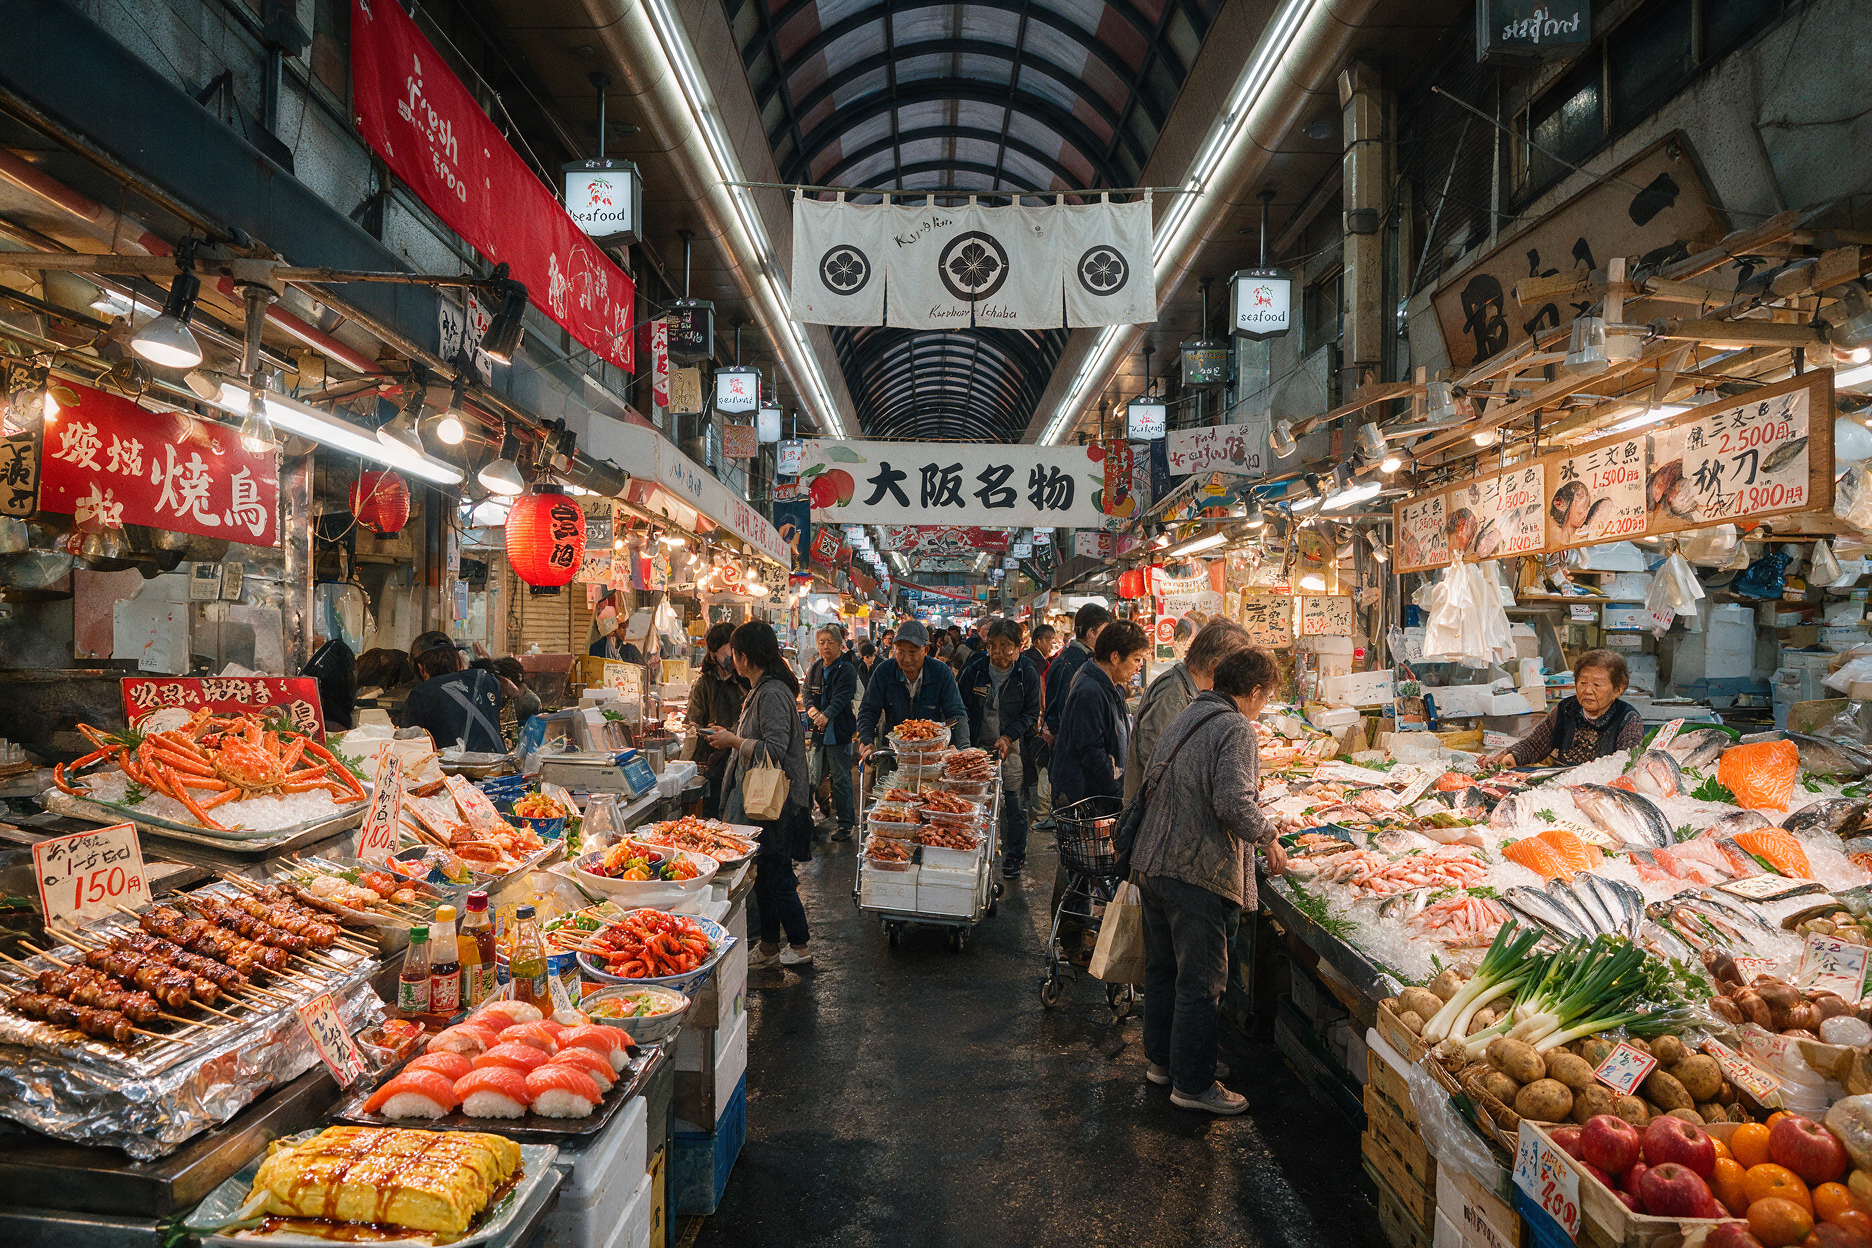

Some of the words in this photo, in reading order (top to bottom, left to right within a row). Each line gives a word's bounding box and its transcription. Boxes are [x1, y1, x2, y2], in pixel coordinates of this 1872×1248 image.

[1240, 309, 1286, 322] seafood
[863, 461, 1075, 511] 大阪名物
[74, 866, 141, 910] 150円
